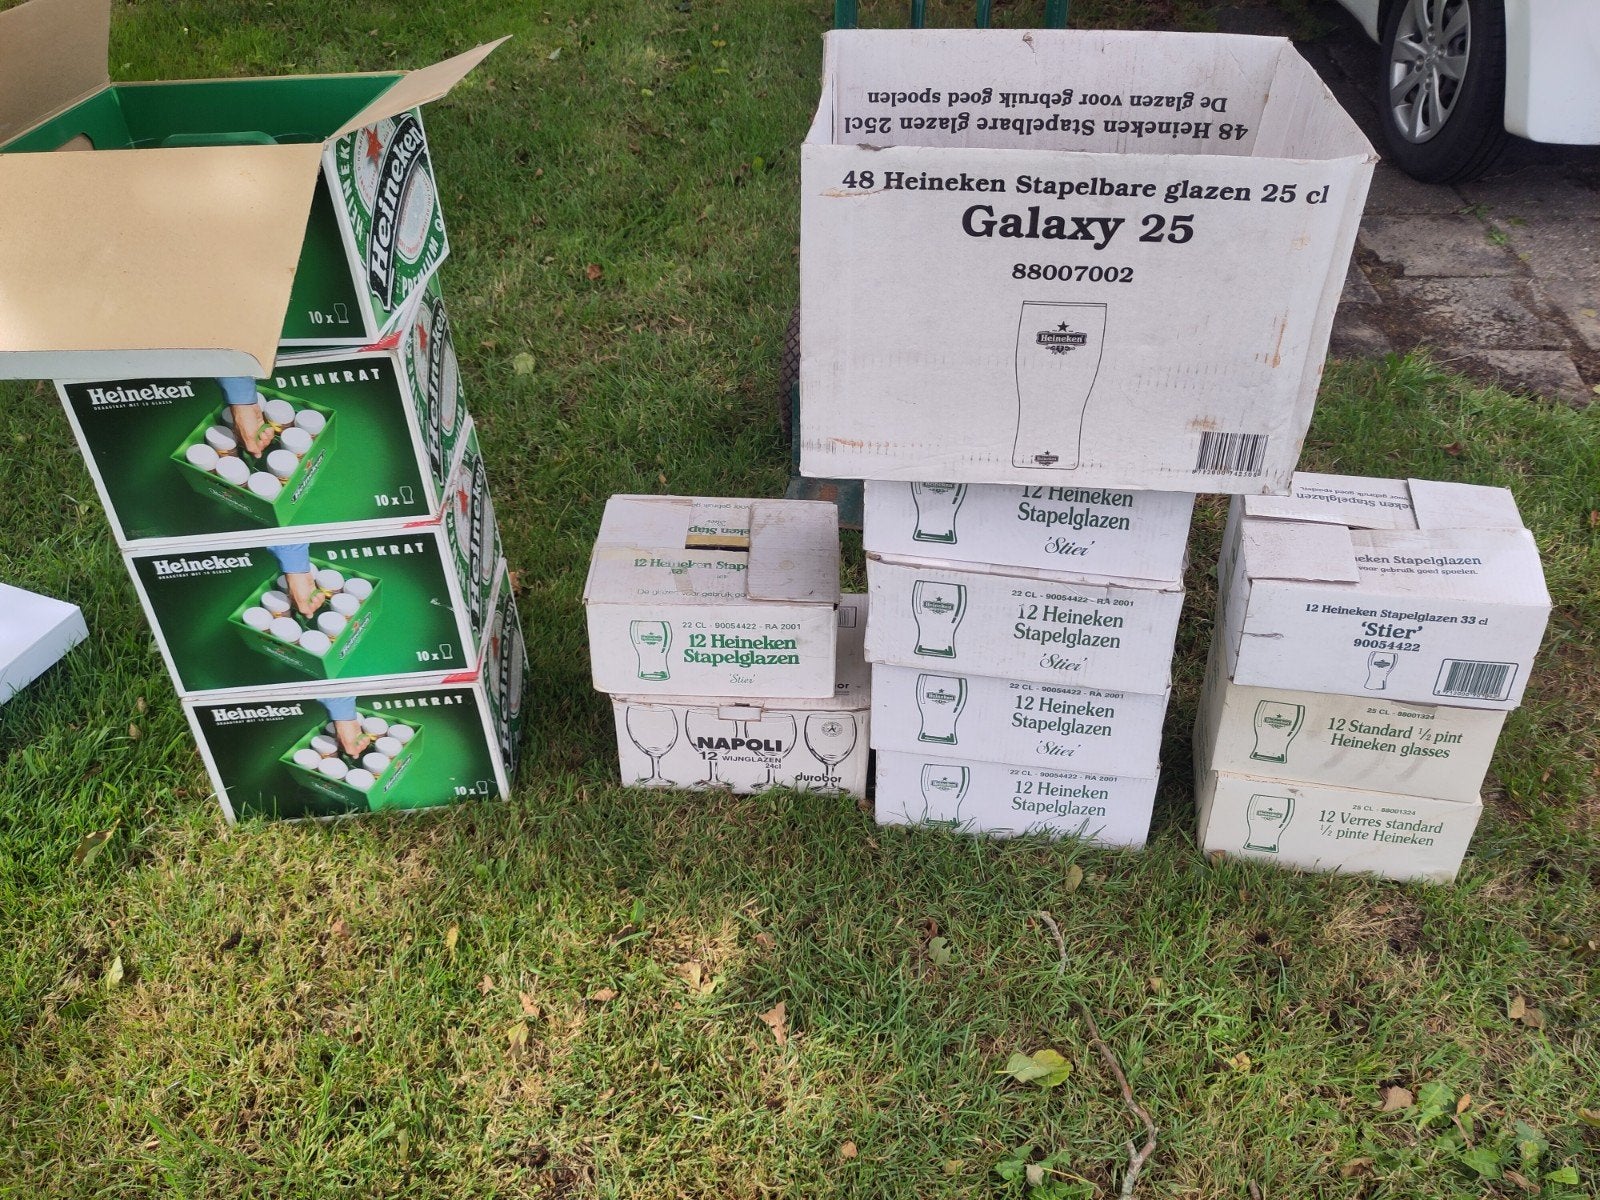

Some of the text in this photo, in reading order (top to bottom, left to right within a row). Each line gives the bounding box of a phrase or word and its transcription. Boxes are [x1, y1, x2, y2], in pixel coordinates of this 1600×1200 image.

[867, 88, 1227, 112] De glazen voor gebruik goed spoelen
[845, 112, 1249, 140] 48 Heineken Stapelbare glazen 25cl
[842, 170, 1330, 204] 48 Heineken Stapelbare glazen 25 cl
[371, 125, 424, 287] Heineken
[962, 204, 1194, 250] Galaxy 25
[1012, 263, 1134, 283] 88007002
[309, 311, 334, 324] 10 x
[1041, 334, 1082, 343] Heineken
[276, 368, 380, 389] DIENKRAT
[87, 384, 195, 405] Heineken
[374, 495, 400, 507] 10 x
[1022, 486, 1133, 507] 12 Heineken
[1296, 492, 1376, 508] Stapelglazen
[1018, 502, 1130, 530] Stapelglazen
[688, 524, 750, 536] eken Stap
[327, 542, 424, 560] DIENKRAT
[153, 556, 253, 576] Heineken
[634, 558, 647, 568] 12
[1393, 555, 1482, 566] Stapelglazen
[1380, 566, 1415, 574] gebruik
[1046, 594, 1088, 603] 90054422
[1018, 604, 1124, 628] 12 Heineken
[1305, 603, 1488, 626] 12 Heineken Stapelglazen 33 cl
[682, 621, 692, 629] 22
[695, 621, 706, 629] CL
[715, 622, 757, 630] 90054422
[689, 633, 797, 650] 12 Heineken
[1014, 622, 1121, 648] Stapelglazen
[1354, 638, 1421, 652] 90054422
[416, 651, 430, 661] 10
[684, 648, 800, 668] Stapelglazen
[1042, 687, 1082, 695] 90054422
[372, 695, 463, 710] DIENKRAT
[1015, 695, 1115, 718] 12 Heineken
[211, 705, 304, 722] Heineken
[1012, 712, 1112, 736] Stapelglazen
[1328, 717, 1346, 731] 12
[1348, 719, 1414, 739] Standard
[1433, 731, 1463, 744] pint
[697, 737, 782, 752] NAPOLI
[1331, 733, 1450, 759] Heineken glasses
[700, 751, 782, 763] 12 WIJNGLAZEN
[795, 772, 842, 783] durobor
[1040, 772, 1078, 780] 90054422
[454, 786, 467, 796] 10
[1015, 780, 1109, 800] 12 Heineken
[1011, 796, 1106, 817] Stapelglazen
[1319, 810, 1443, 834] 12 Verres standard
[1336, 828, 1369, 839] pinte
[1373, 830, 1434, 846] Heineken
